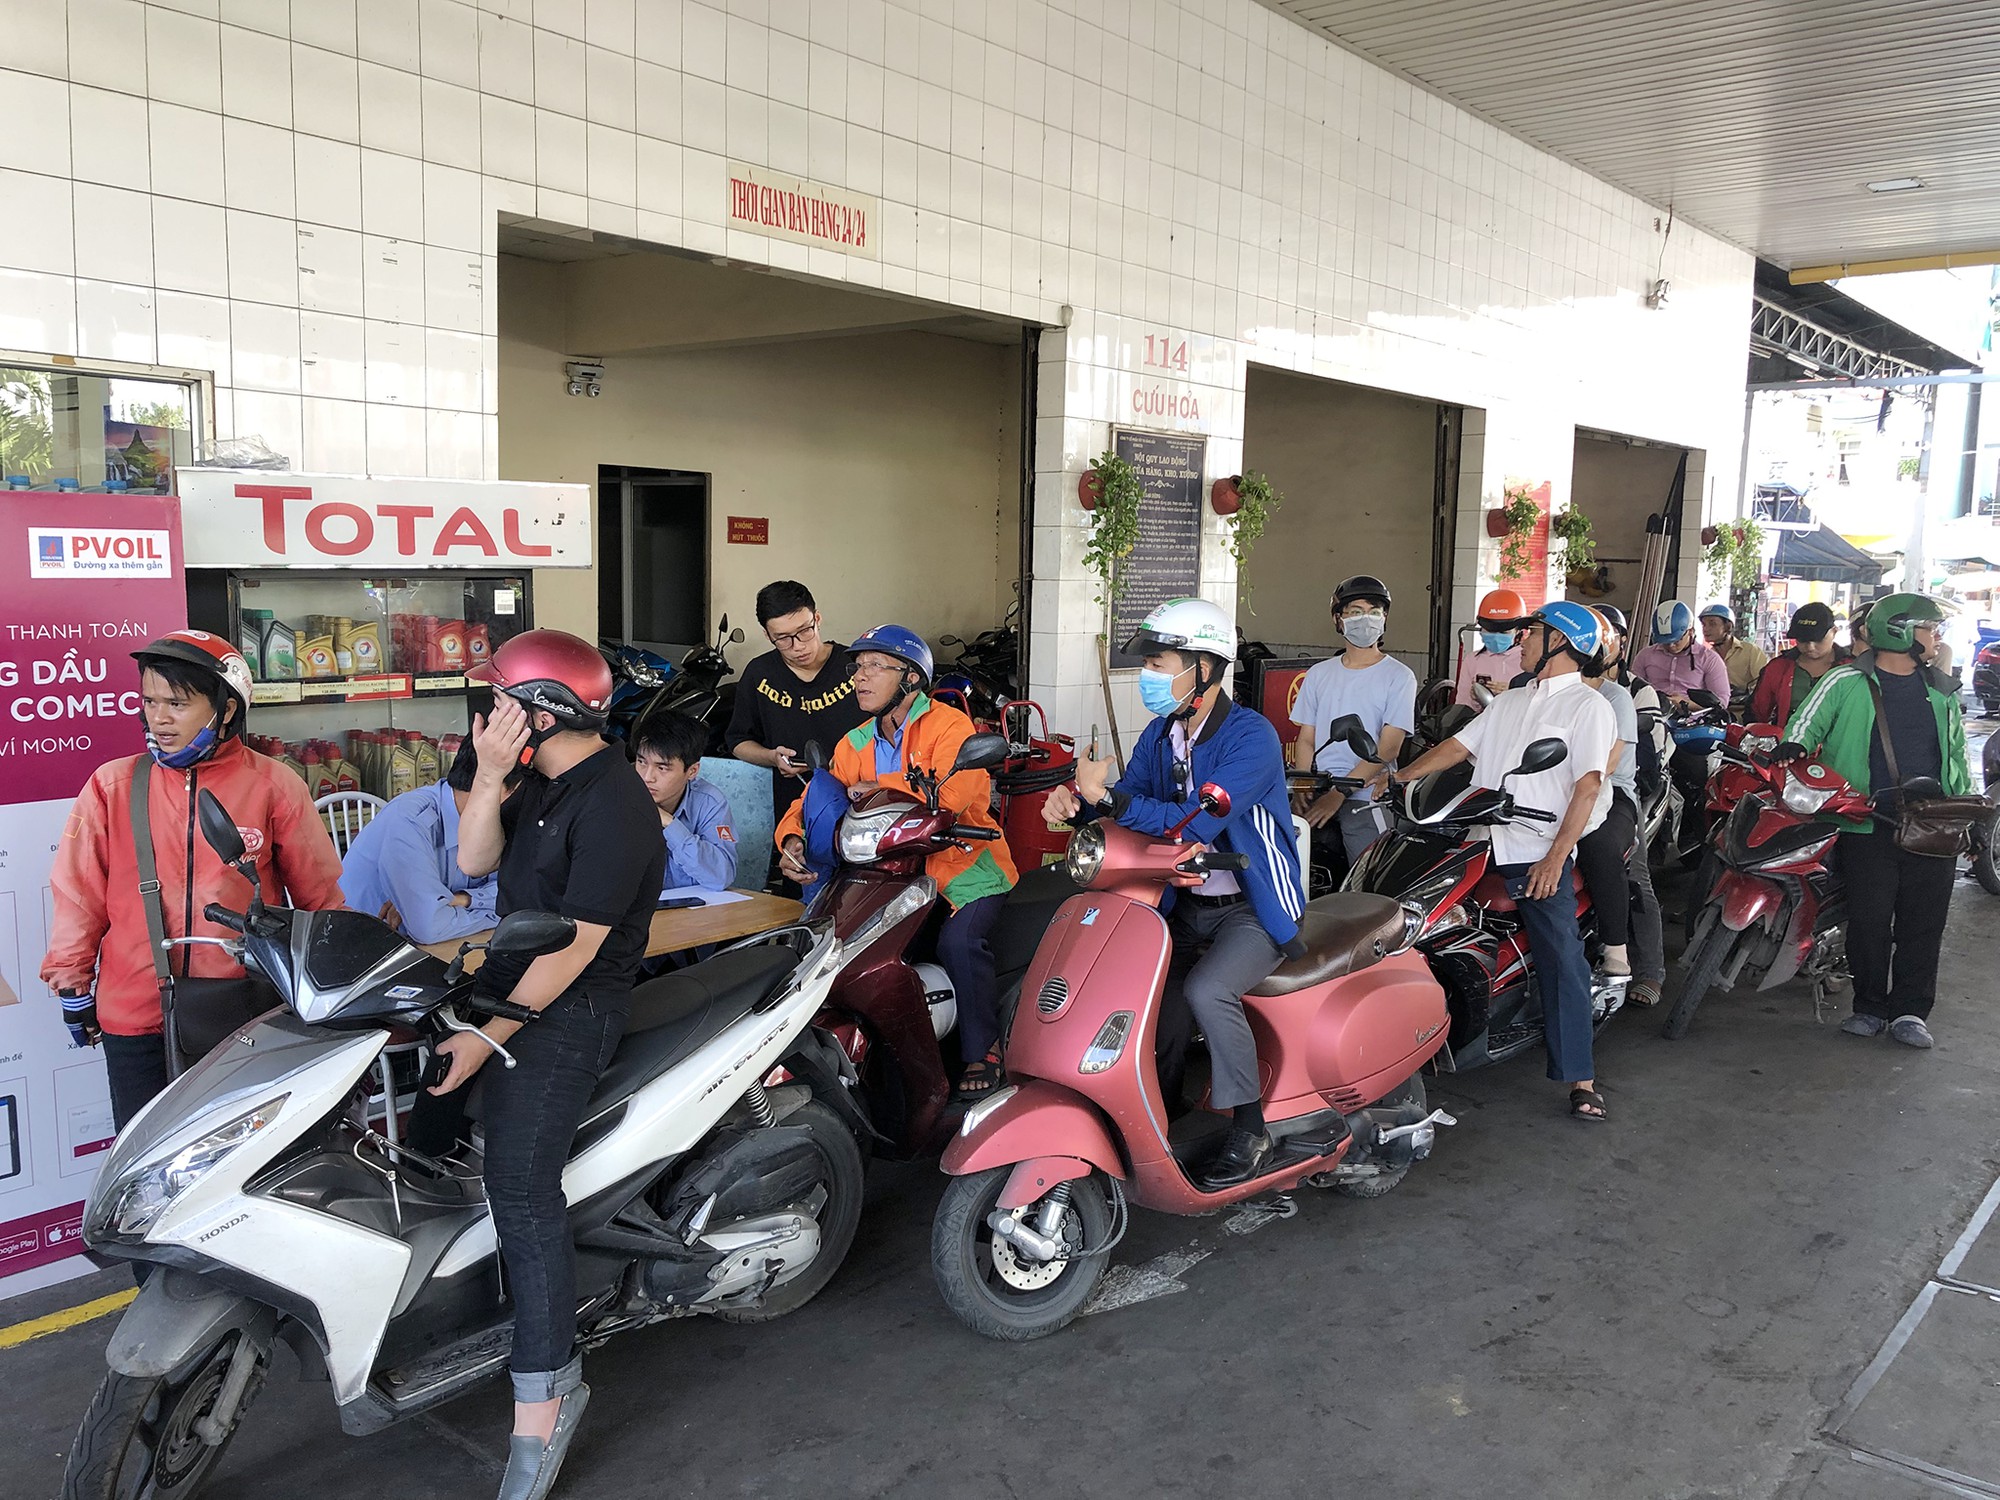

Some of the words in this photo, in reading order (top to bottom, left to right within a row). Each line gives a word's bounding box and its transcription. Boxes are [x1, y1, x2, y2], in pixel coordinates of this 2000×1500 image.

[731, 168, 759, 222] THỜI
[761, 185, 787, 230] GIAN
[788, 182, 810, 234] BÁN
[811, 188, 841, 242] HÀNG
[842, 205, 866, 248] 24/24
[1144, 334, 1188, 372] 114
[1159, 456, 1170, 465] LAO
[234, 484, 552, 557] TOTAL
[72, 536, 162, 559] PVOIL
[73, 561, 107, 570] Đường
[121, 560, 144, 569] thêm
[146, 559, 163, 570] gần
[6, 624, 82, 641] THANH
[89, 619, 148, 639] TOÁN
[32, 647, 107, 685] DẦU
[10, 691, 143, 722] COMEC
[531, 687, 576, 715] Vespa
[756, 678, 793, 708] bad
[23, 735, 92, 755] MOMO
[198, 1213, 250, 1243] HONDA
[20, 1239, 36, 1249] Play
